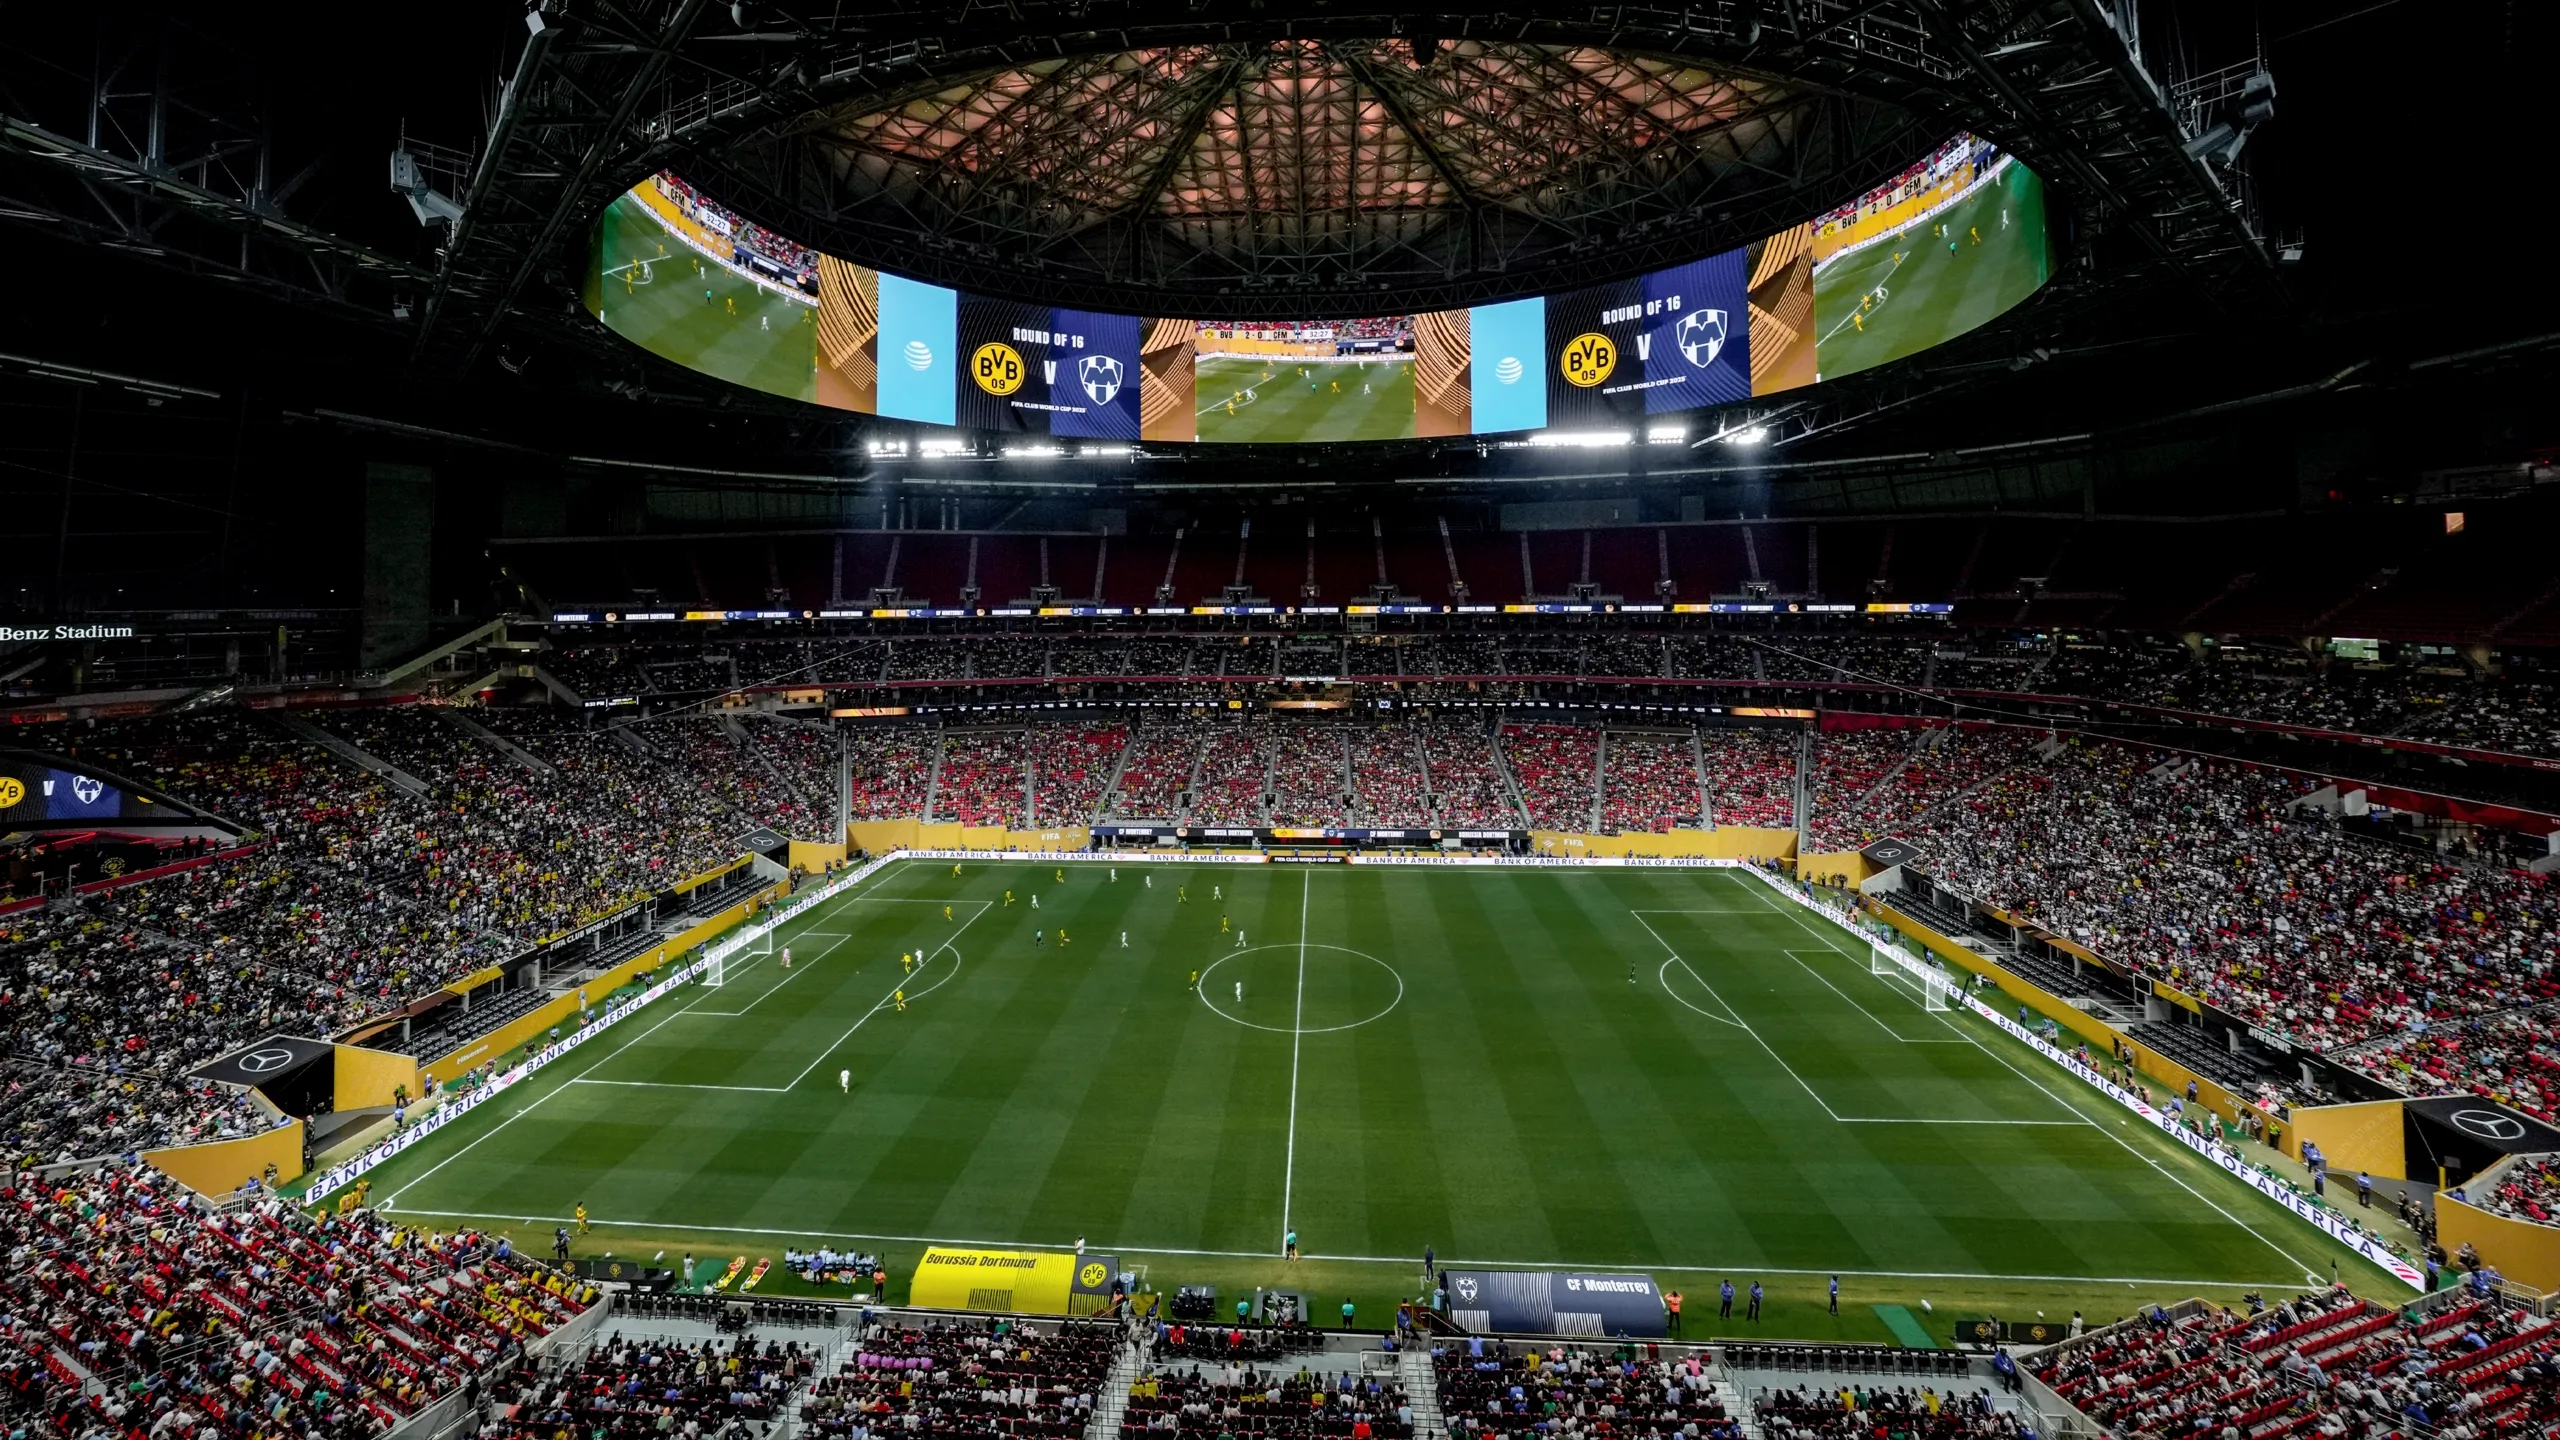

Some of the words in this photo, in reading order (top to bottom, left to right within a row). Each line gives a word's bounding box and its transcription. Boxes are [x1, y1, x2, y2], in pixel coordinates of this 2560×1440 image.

[1904, 177, 1921, 195] CFM
[670, 188, 685, 207] CFM
[706, 214, 726, 230] 32:27
[1842, 213, 1858, 229] BVB
[1603, 304, 1642, 325] ROUND
[1647, 300, 1662, 315] OF
[1667, 295, 1681, 311] 16
[1013, 327, 1050, 345] ROUND
[1054, 335, 1067, 346] OF
[1071, 335, 1084, 348] 16
[1220, 330, 1233, 339] BVB
[1273, 330, 1288, 339] CFM
[1309, 330, 1329, 338] 32:27
[1570, 339, 1609, 372] BVB
[1637, 334, 1652, 361] V
[980, 348, 1018, 380] BVB
[1043, 360, 1057, 385] V
[991, 378, 1006, 389] 09
[1581, 370, 1596, 381] 09
[1617, 385, 1632, 393] CLUB
[1633, 382, 1655, 390] WORLD
[1656, 379, 1669, 387] CUP
[1040, 403, 1059, 411] WORLD
[0, 627, 50, 641] Benz
[55, 625, 133, 639] Stadium
[43, 781, 55, 796] V
[1041, 833, 1060, 841] FIFA
[1564, 839, 1584, 847] FIFA
[950, 851, 991, 859] AMERICA
[1410, 857, 1456, 865] AMERICA
[838, 876, 855, 890] BANK
[856, 871, 864, 882] OF
[863, 857, 888, 877] AMERICA
[1742, 862, 1761, 876] BANK
[1761, 873, 1769, 882] OF
[1767, 877, 1795, 898] AMERICA
[762, 914, 782, 932] BANK
[783, 909, 793, 920] OF
[792, 892, 826, 915] AMERICA
[1808, 900, 1827, 917] BANK
[1829, 912, 1840, 924] OF
[1841, 919, 1875, 944] AMERICA
[550, 940, 566, 951] FIFA
[567, 931, 584, 943] CLUB
[585, 920, 609, 935] WORLD
[610, 913, 623, 924] CUP
[623, 907, 639, 918] 2025
[664, 966, 692, 991] BANK
[694, 960, 706, 973] OF
[706, 937, 747, 966] AMERICA
[1890, 948, 1913, 972] BANK
[1916, 965, 1928, 979] OF
[1930, 975, 1977, 1009] AMERICA
[526, 1043, 565, 1073] BANK
[569, 1029, 586, 1047] OF
[589, 998, 643, 1035] AMERICA
[2248, 1027, 2292, 1054] #FIFACWC
[457, 1044, 488, 1065] Hisense
[1999, 1016, 2033, 1046] BANK
[2037, 1041, 2053, 1060] OF
[2057, 1053, 2127, 1104] AMERICA
[312, 1158, 373, 1201] BANK
[381, 1137, 407, 1159] OF
[412, 1085, 494, 1141] AMERICA
[2163, 1117, 2216, 1161] BANK
[2223, 1156, 2249, 1178] OF
[2257, 1173, 2375, 1261] AMERICA
[926, 1254, 978, 1266] Borussia
[979, 1256, 1037, 1269] Dortmund
[1083, 1265, 1104, 1279] BVB
[1567, 1279, 1580, 1291] CF
[1583, 1279, 1651, 1295] Monterrey
